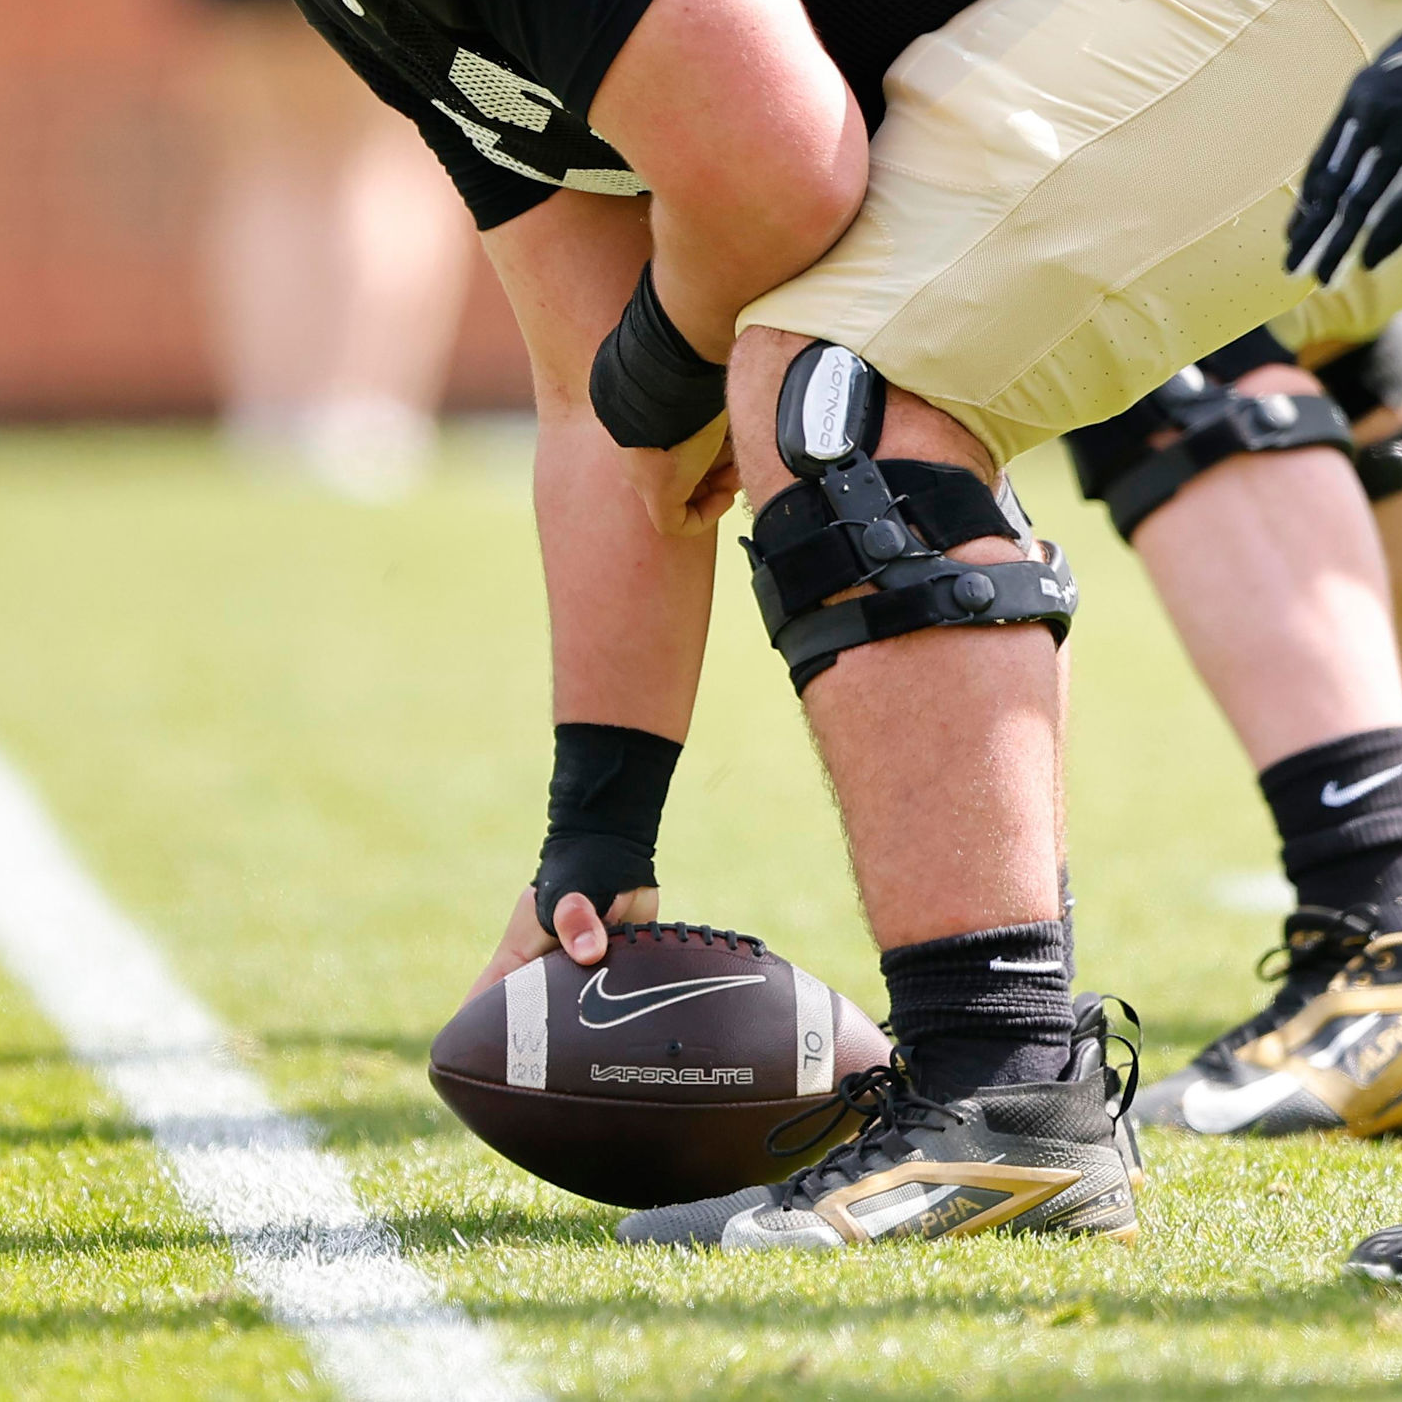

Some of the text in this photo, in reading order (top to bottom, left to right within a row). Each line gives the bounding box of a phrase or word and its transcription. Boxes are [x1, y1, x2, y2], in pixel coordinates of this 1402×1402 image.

[819, 356, 845, 449] DONJOY
[590, 1063, 754, 1085] VAPOR ELITE
